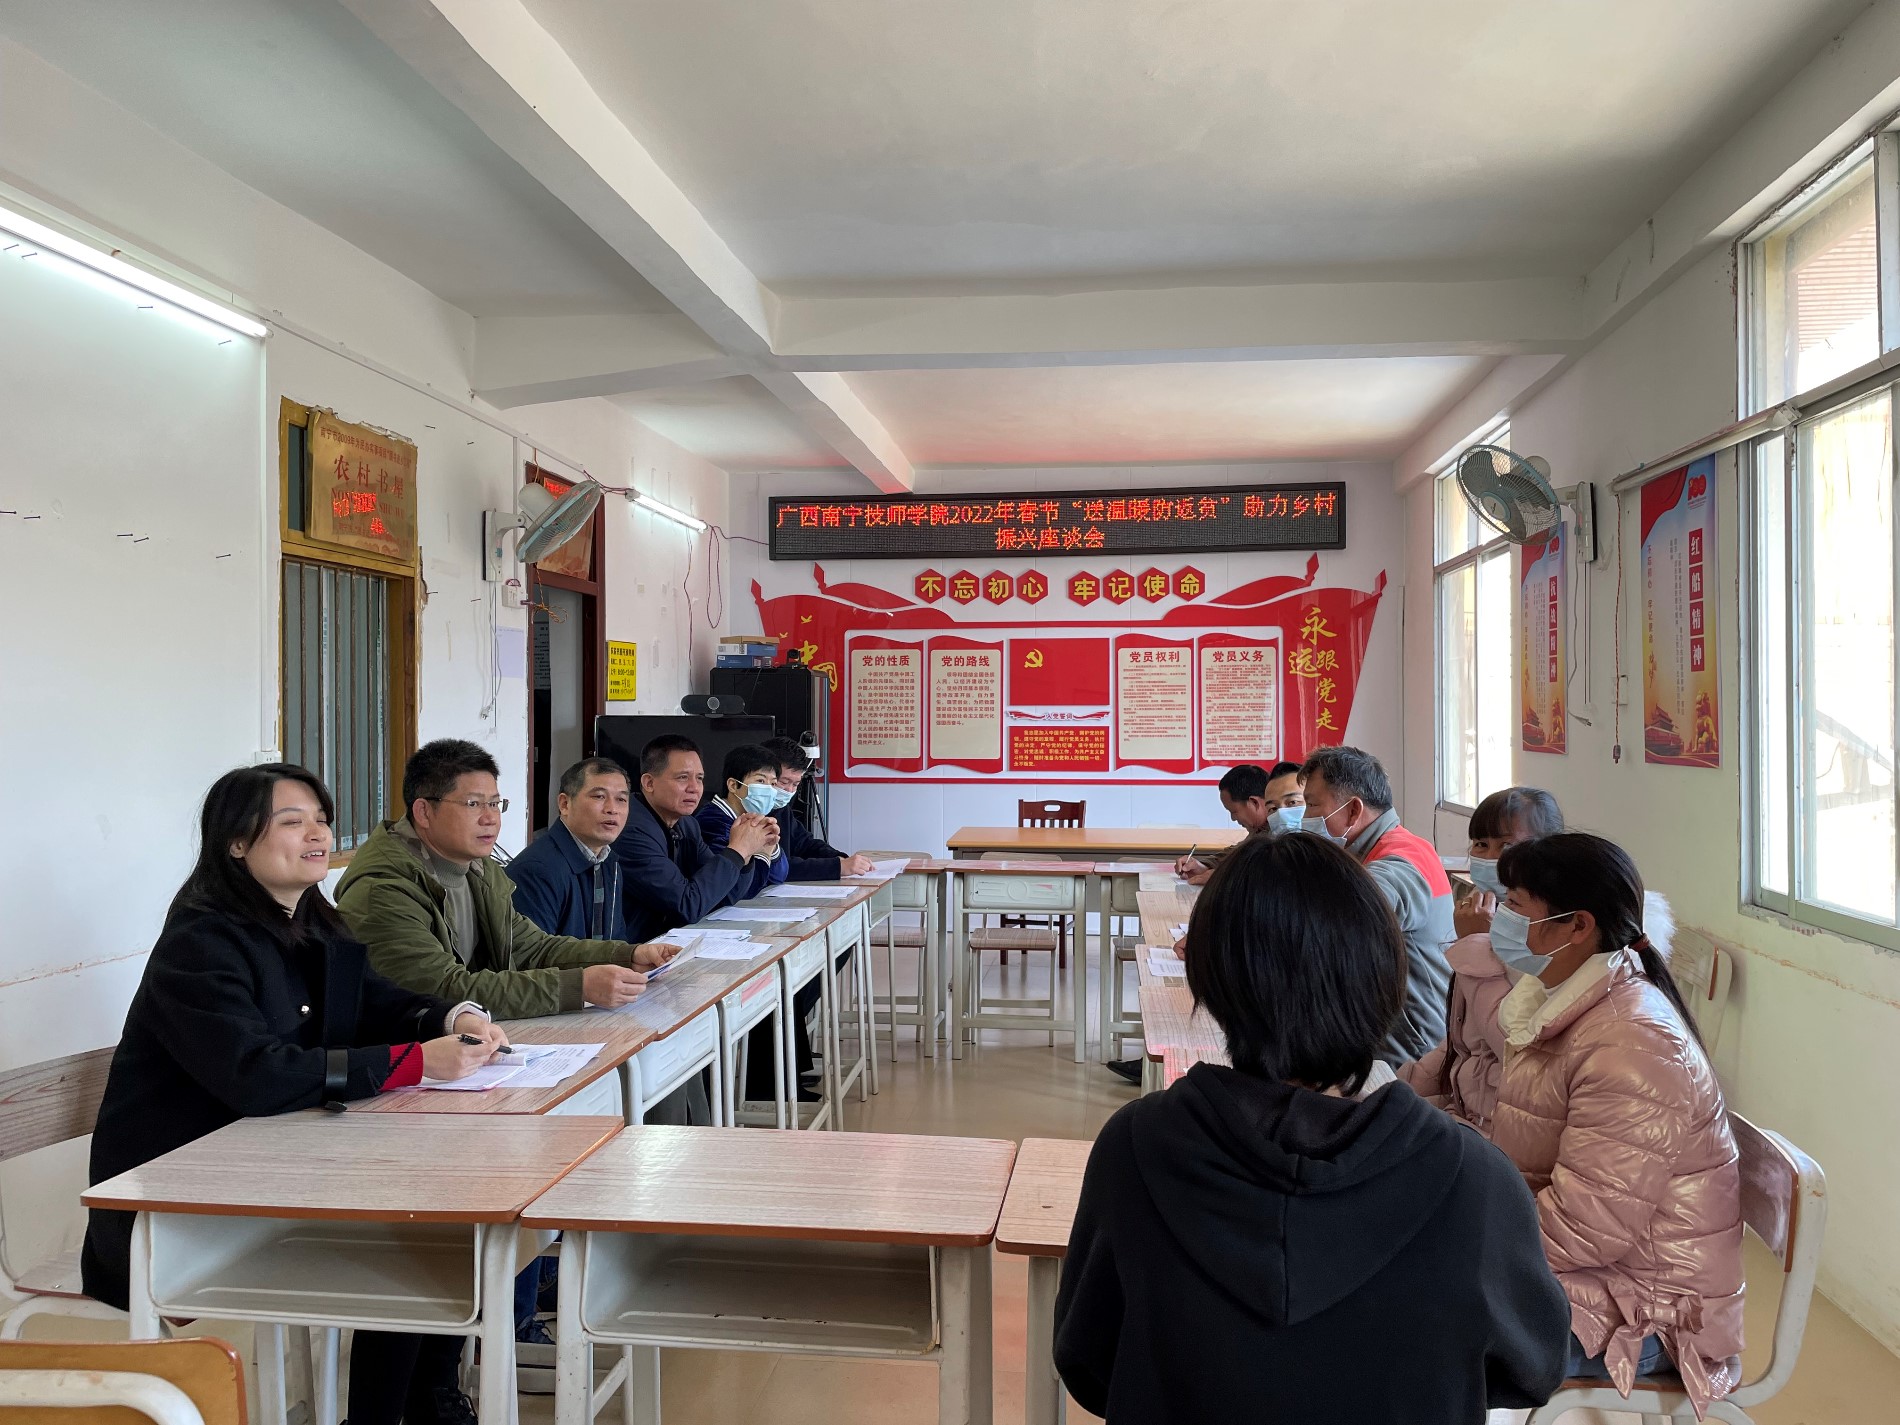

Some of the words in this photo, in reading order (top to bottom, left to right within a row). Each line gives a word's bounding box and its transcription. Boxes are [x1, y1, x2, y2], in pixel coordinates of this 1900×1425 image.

[334, 454, 404, 499] 农村书屋
[995, 526, 1105, 551] 振兴座谈会
[920, 576, 1044, 600] 不忘初心
[1074, 575, 1201, 600] 牢记使命
[1689, 536, 1703, 667] 红船精神
[862, 655, 910, 667] 党的性质
[941, 655, 990, 667] 党的路线
[1129, 650, 1181, 663] 党员权利
[1212, 650, 1265, 663] 党员义务
